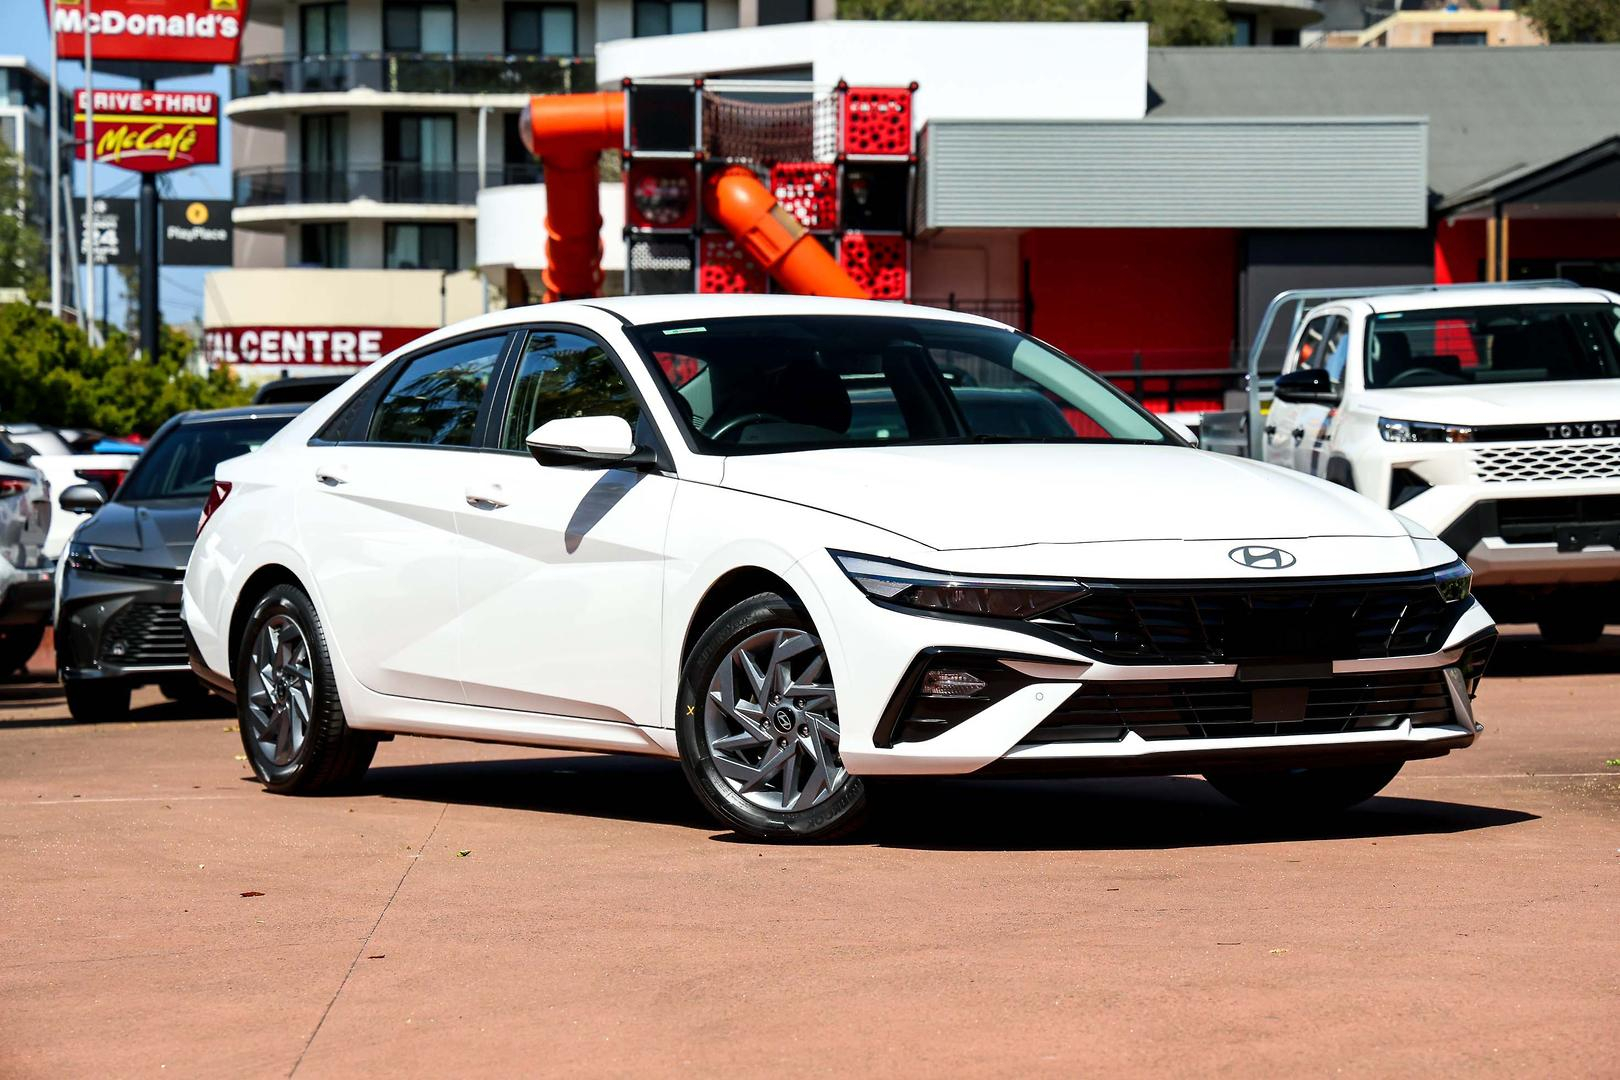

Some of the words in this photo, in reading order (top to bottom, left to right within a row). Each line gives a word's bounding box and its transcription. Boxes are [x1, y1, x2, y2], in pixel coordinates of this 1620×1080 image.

[56, 8, 239, 38] McDonald's
[239, 330, 383, 363] CENTRE
[1545, 423, 1619, 439] TOYOT
